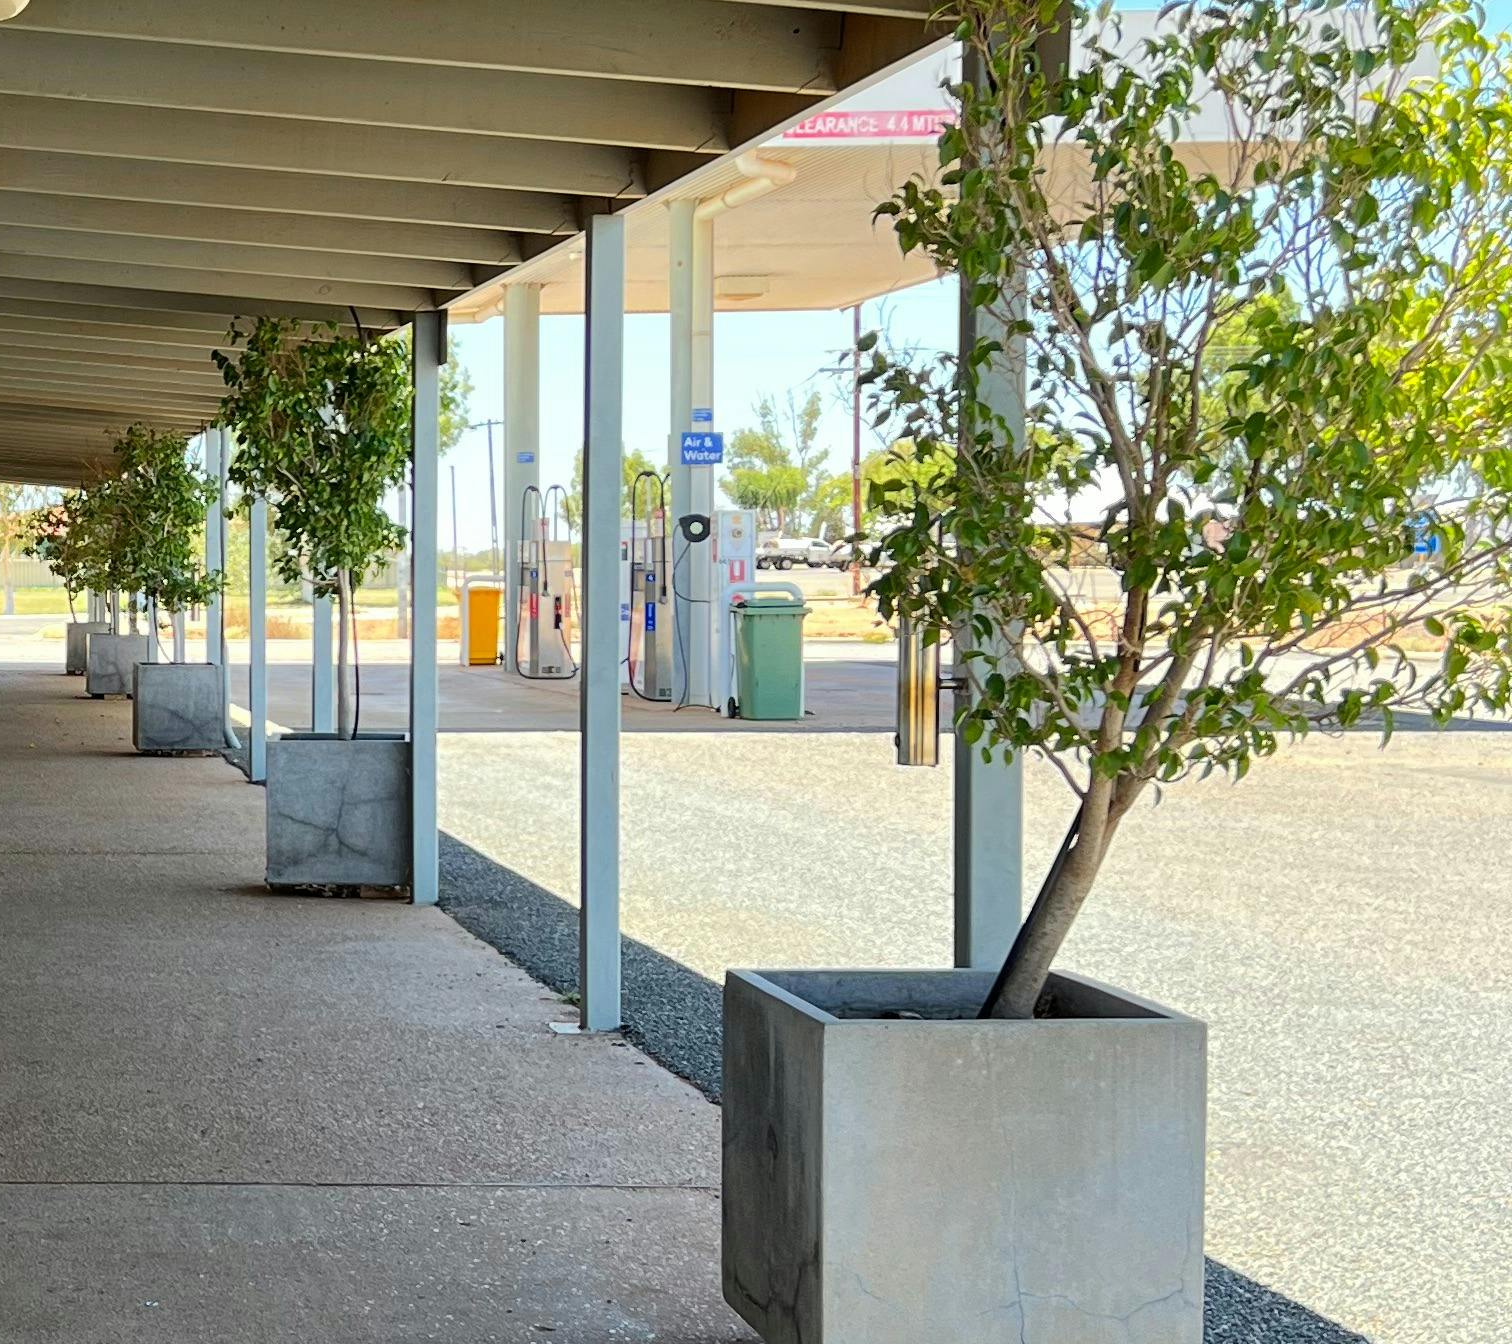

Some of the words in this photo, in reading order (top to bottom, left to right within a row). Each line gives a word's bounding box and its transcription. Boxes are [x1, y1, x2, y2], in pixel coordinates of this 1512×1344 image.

[787, 115, 878, 134] LEARANCE
[887, 115, 908, 132] 4.4
[683, 436, 701, 447] Air
[703, 436, 713, 448] &
[683, 450, 722, 461] Water
